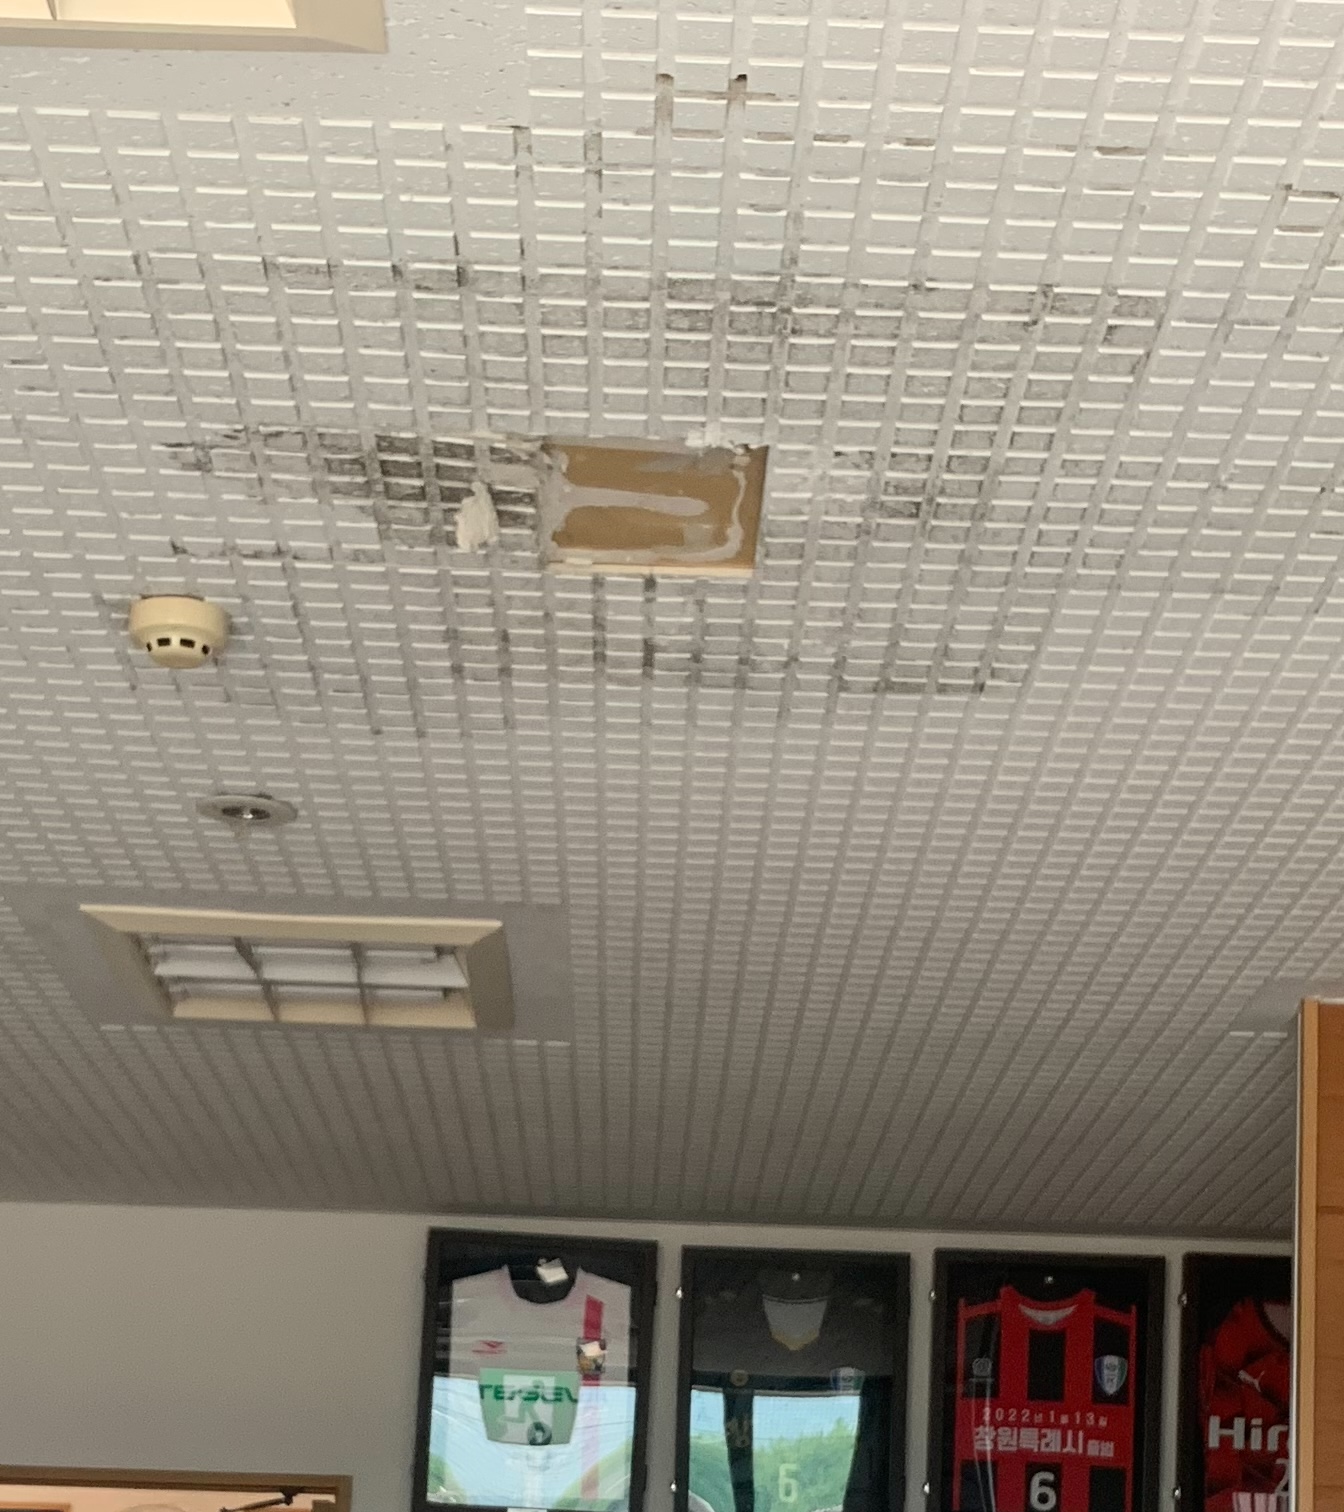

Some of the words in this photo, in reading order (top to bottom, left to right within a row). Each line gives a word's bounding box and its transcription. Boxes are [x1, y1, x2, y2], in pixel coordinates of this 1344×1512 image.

[1208, 1415, 1289, 1453] Hir
[778, 1463, 798, 1503] 6
[1030, 1471, 1056, 1511] 6
